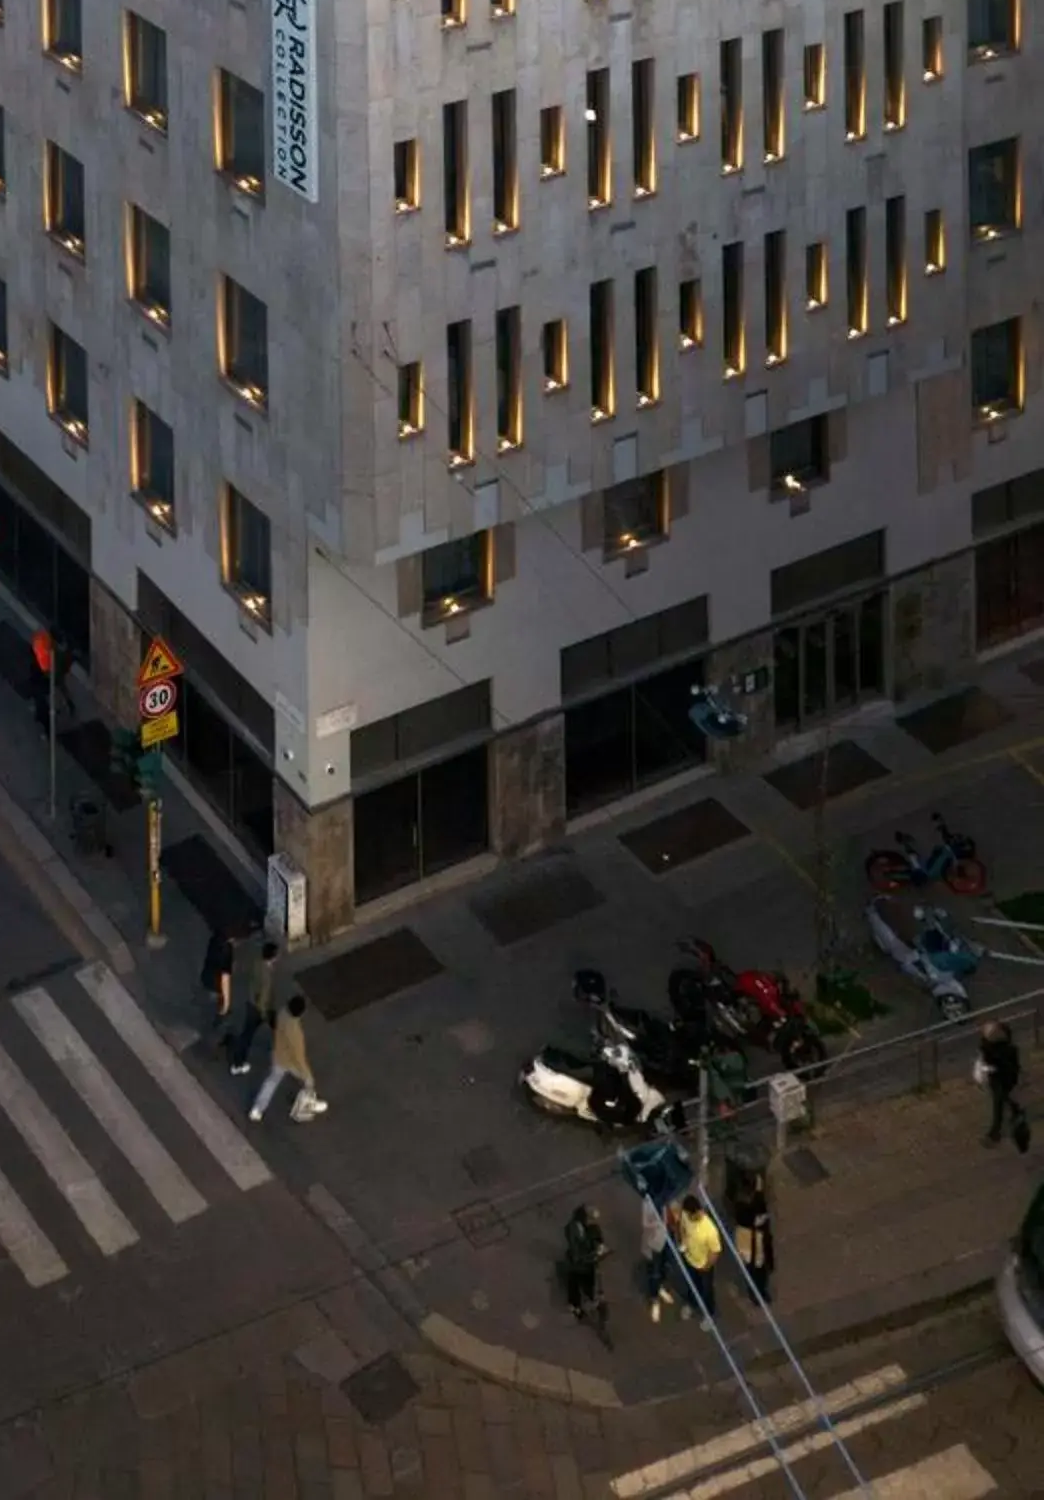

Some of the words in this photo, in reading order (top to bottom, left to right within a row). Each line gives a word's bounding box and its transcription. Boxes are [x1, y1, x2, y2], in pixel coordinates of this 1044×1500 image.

[275, 28, 287, 179] COLLECTION
[288, 35, 307, 192] RADISSON
[149, 689, 169, 709] 30
